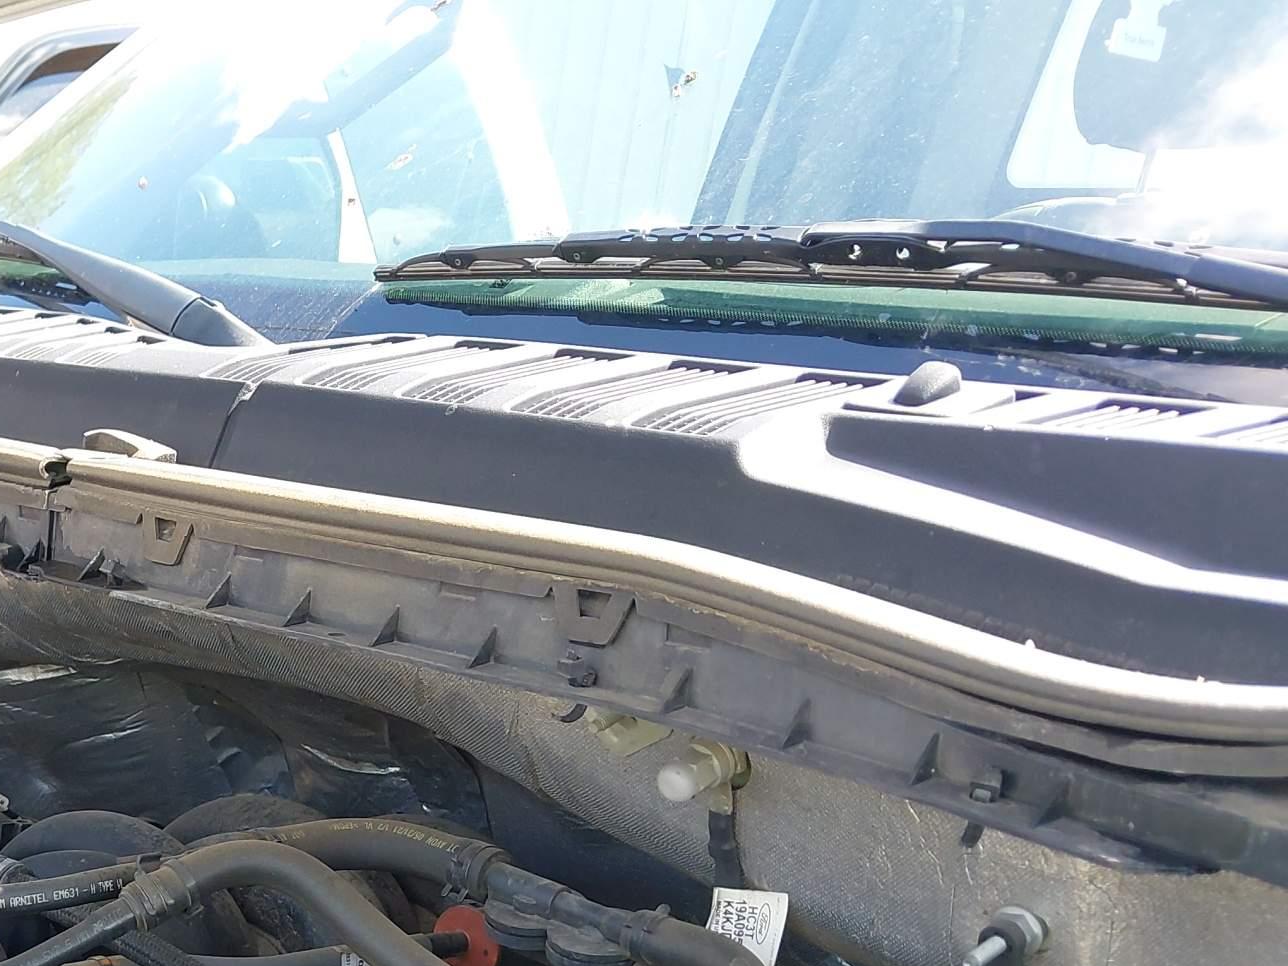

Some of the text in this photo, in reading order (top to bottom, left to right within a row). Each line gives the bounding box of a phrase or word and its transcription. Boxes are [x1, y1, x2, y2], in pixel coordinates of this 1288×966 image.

[9, 893, 49, 908] ARNITEL
[53, 887, 79, 901] EM631
[99, 881, 115, 893] TYPE
[744, 906, 758, 940] HC3T
